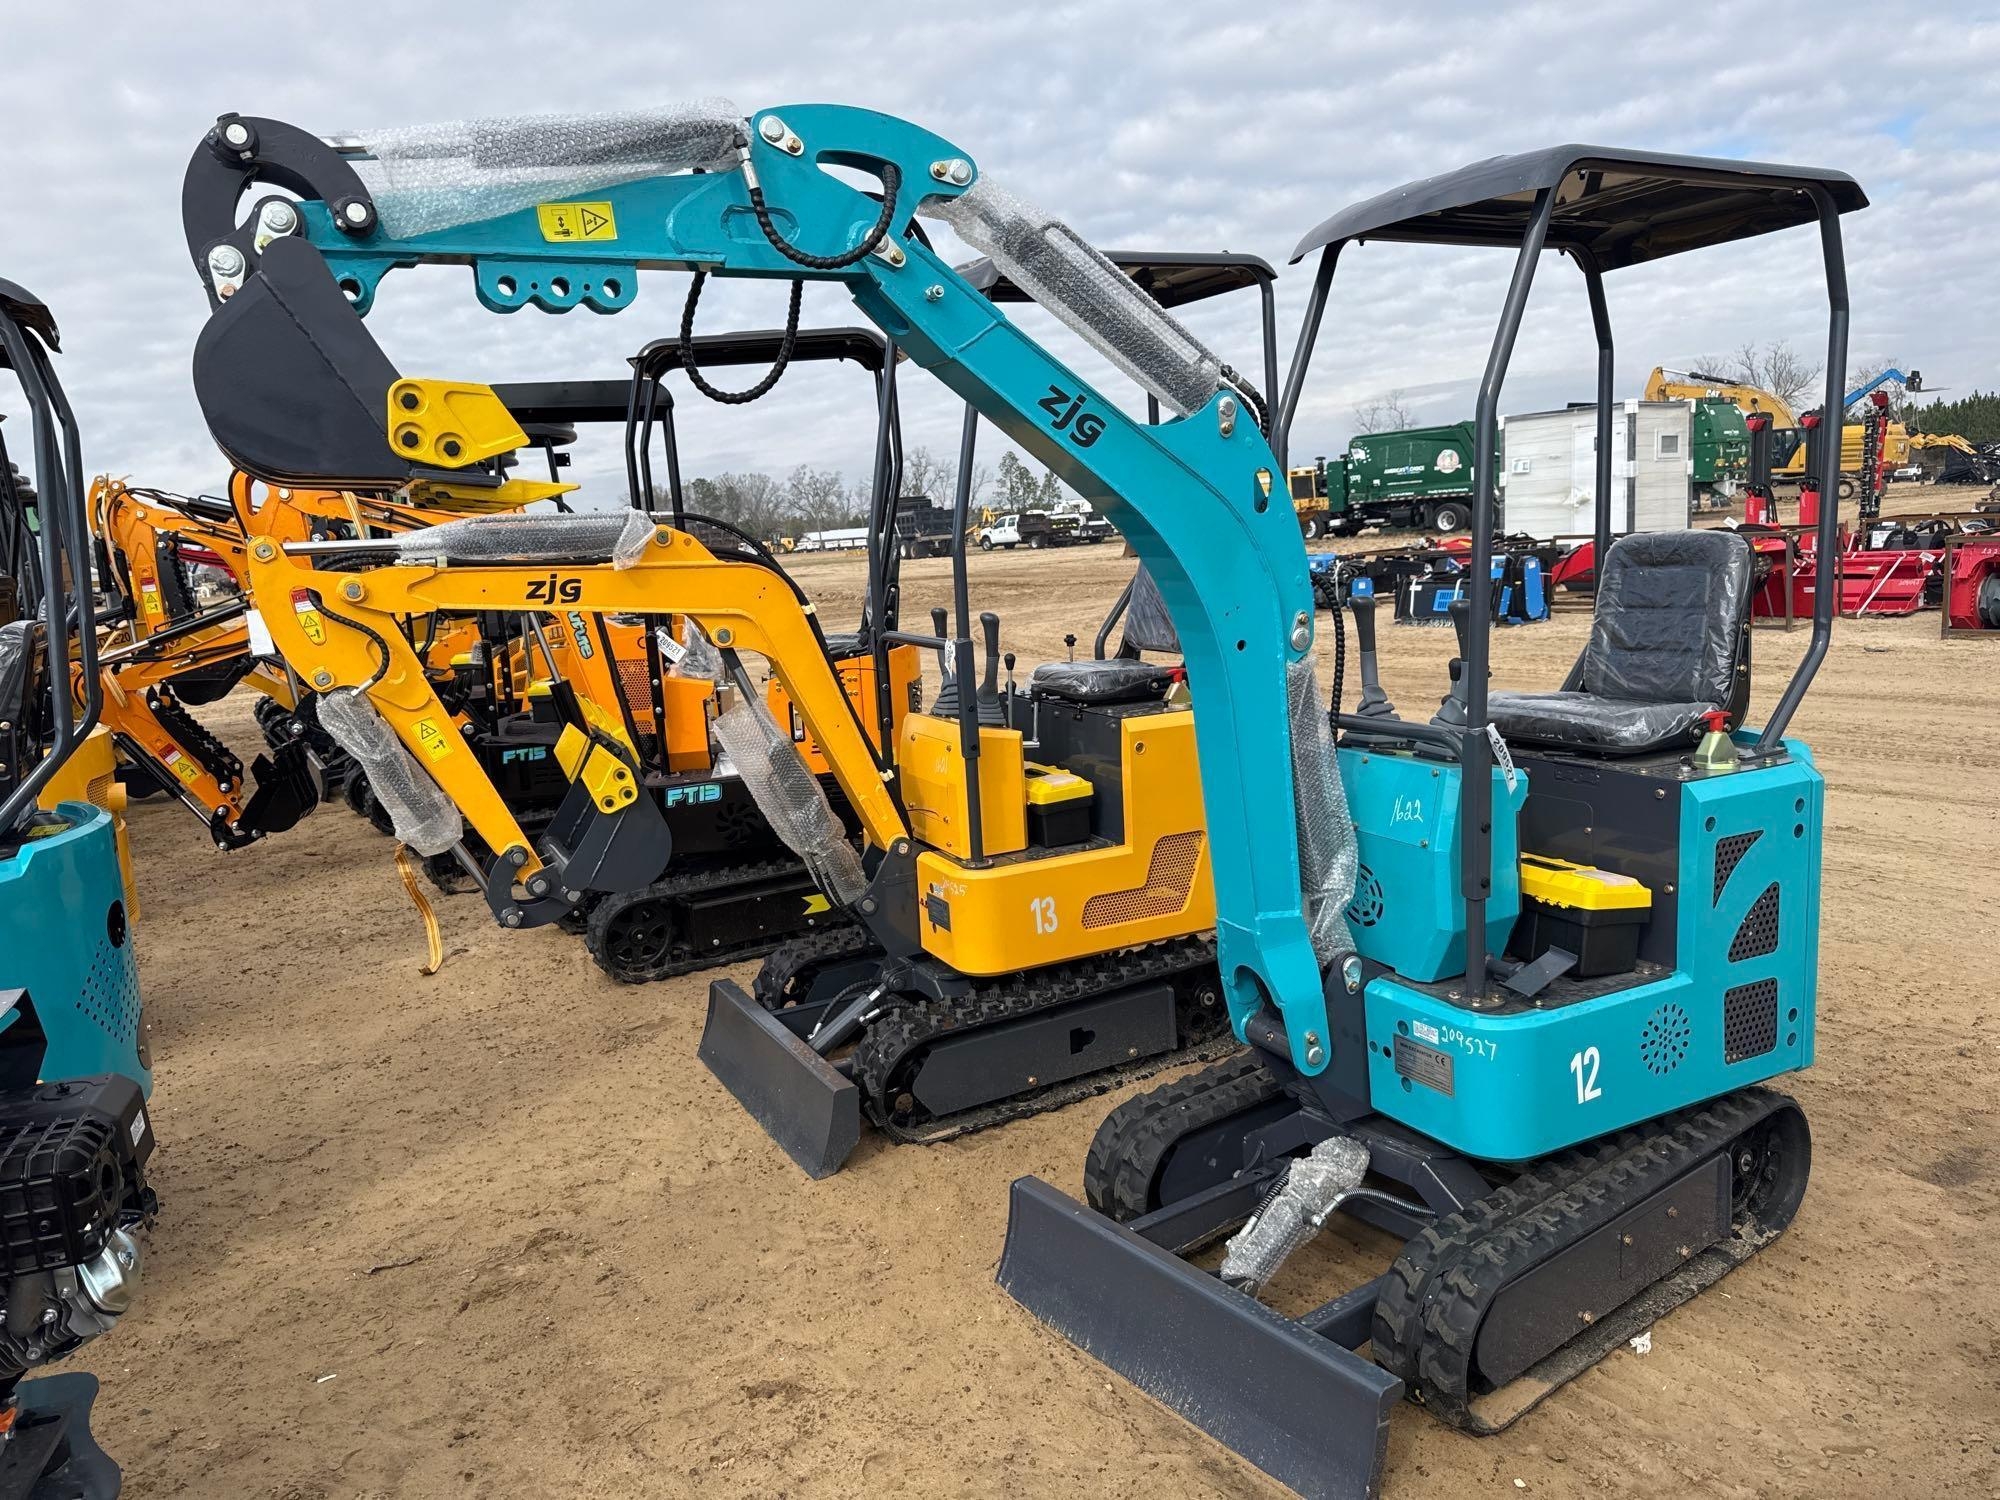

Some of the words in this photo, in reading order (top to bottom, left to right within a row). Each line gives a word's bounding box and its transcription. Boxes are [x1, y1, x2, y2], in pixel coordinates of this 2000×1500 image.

[1037, 384, 1107, 448] zjg
[525, 574, 582, 605] zjg
[567, 611, 594, 659] uture
[666, 784, 722, 807] FT13
[1390, 794, 1423, 827] 1622
[1030, 896, 1058, 935] 13
[1441, 1025, 1497, 1062] 209527
[1570, 1046, 1602, 1105] 12
